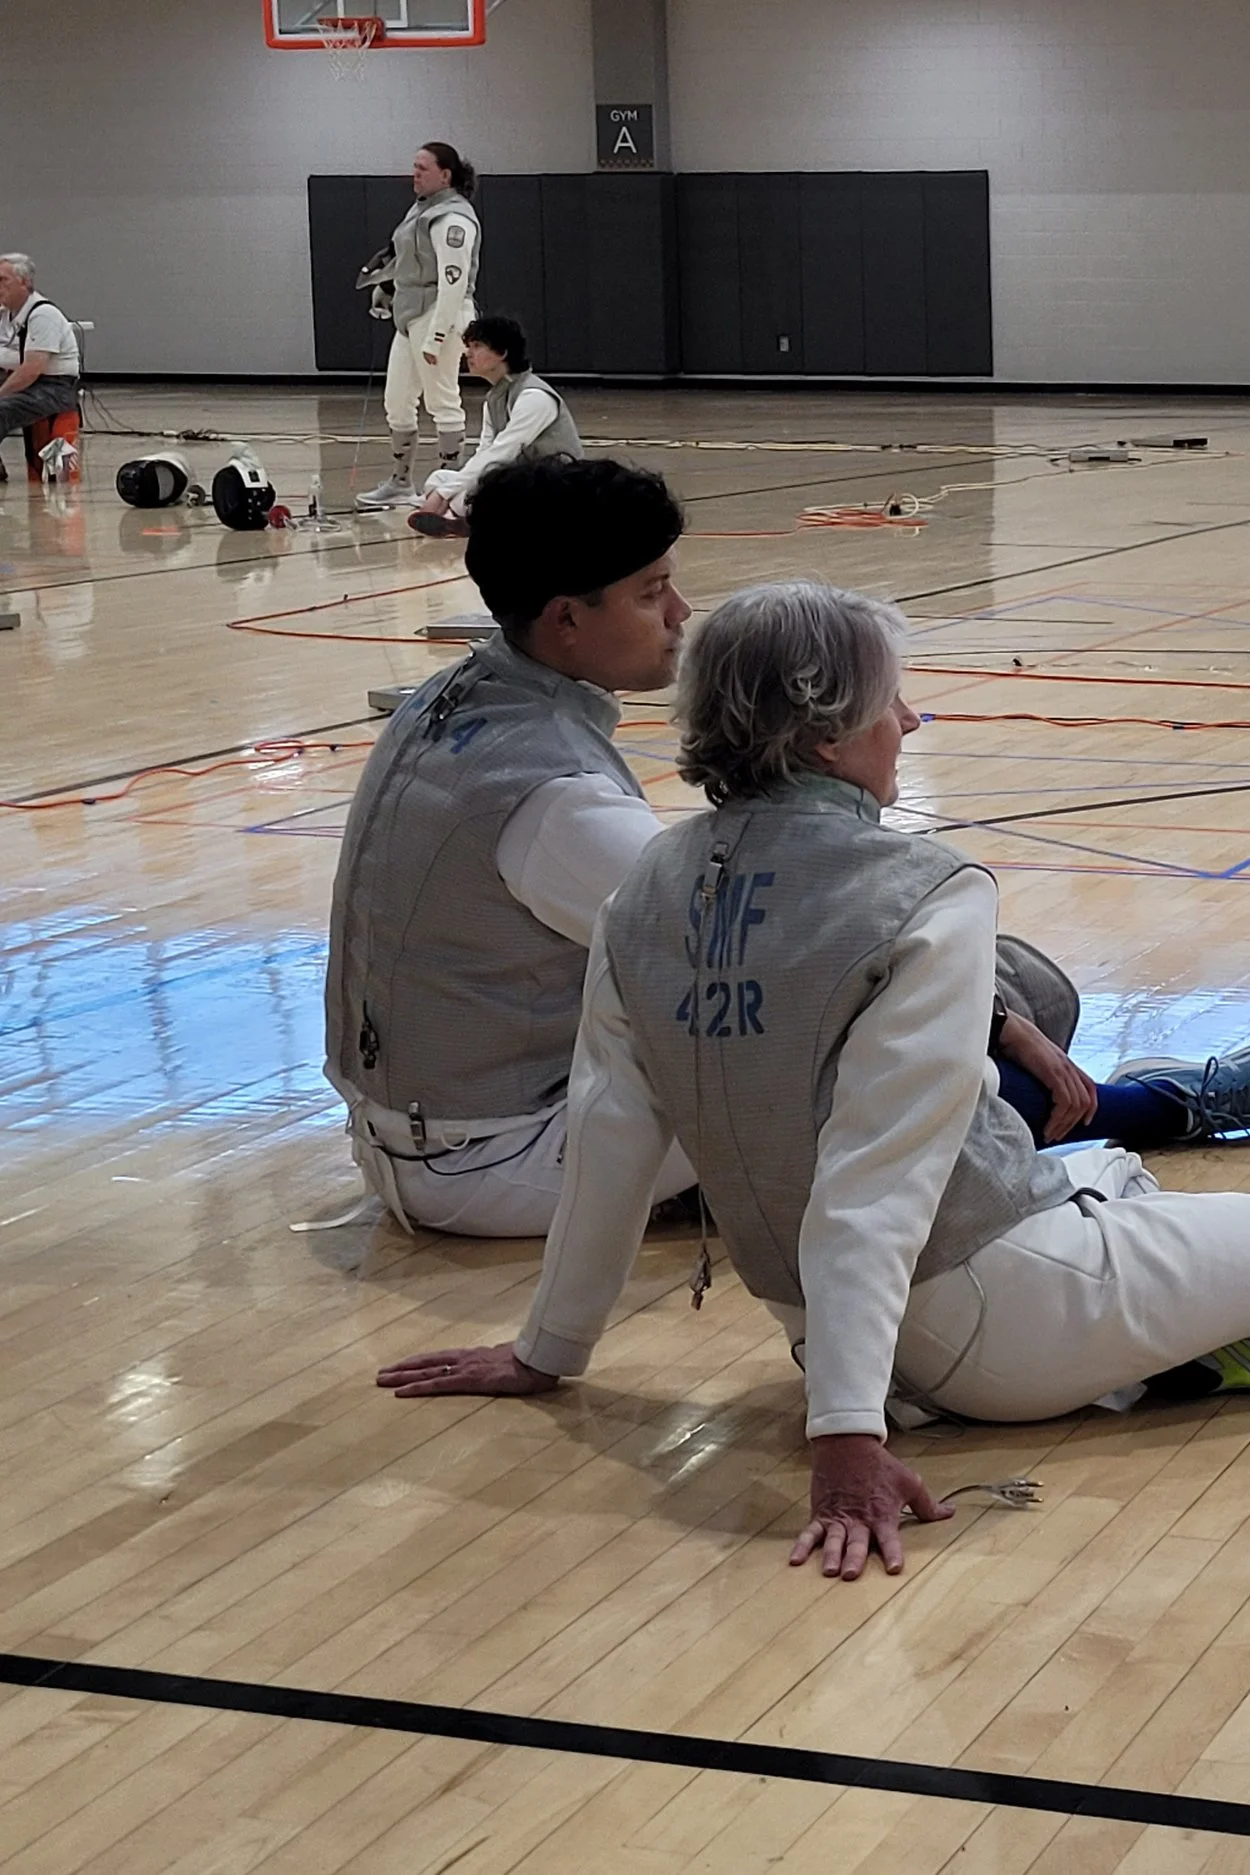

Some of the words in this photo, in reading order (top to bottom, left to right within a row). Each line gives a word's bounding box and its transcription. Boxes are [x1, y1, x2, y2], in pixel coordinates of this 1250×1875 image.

[610, 109, 638, 122] GYM
[613, 126, 637, 154] A
[676, 979, 765, 1037] 42R
